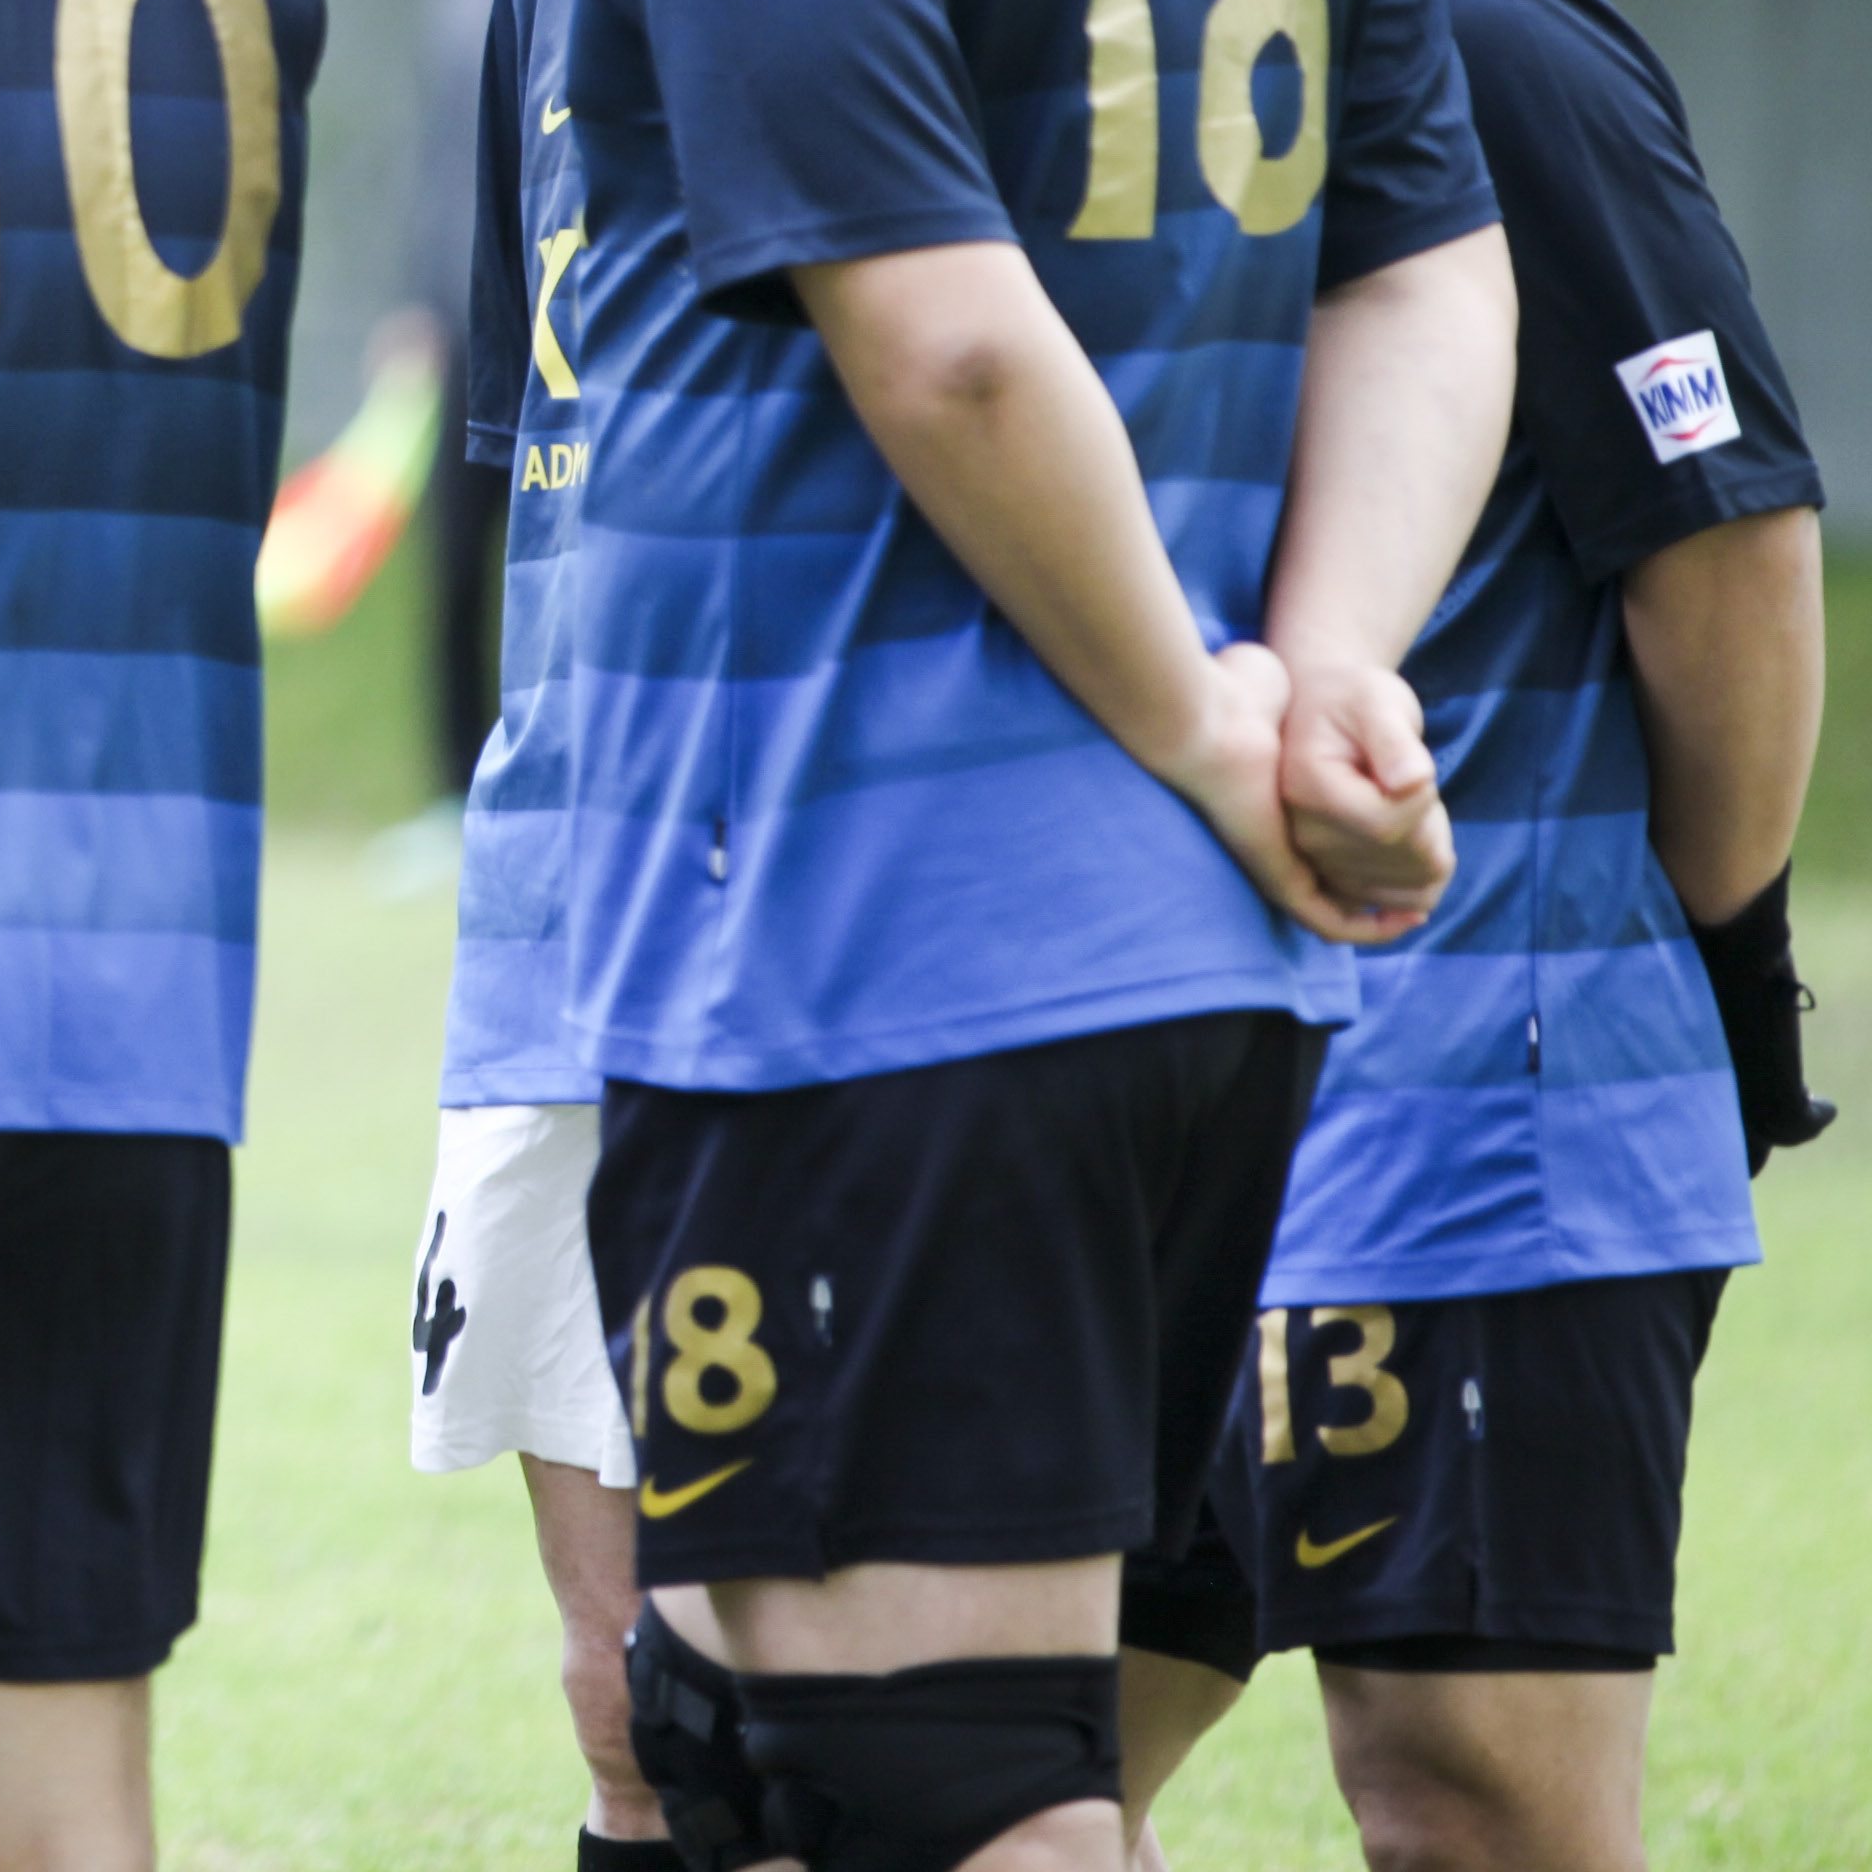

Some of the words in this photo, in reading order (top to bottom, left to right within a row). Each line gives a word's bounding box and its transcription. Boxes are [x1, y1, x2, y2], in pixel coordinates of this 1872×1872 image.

[533, 204, 589, 400] K
[632, 1265, 777, 1438] 18
[1256, 1304, 1409, 1466] 13
